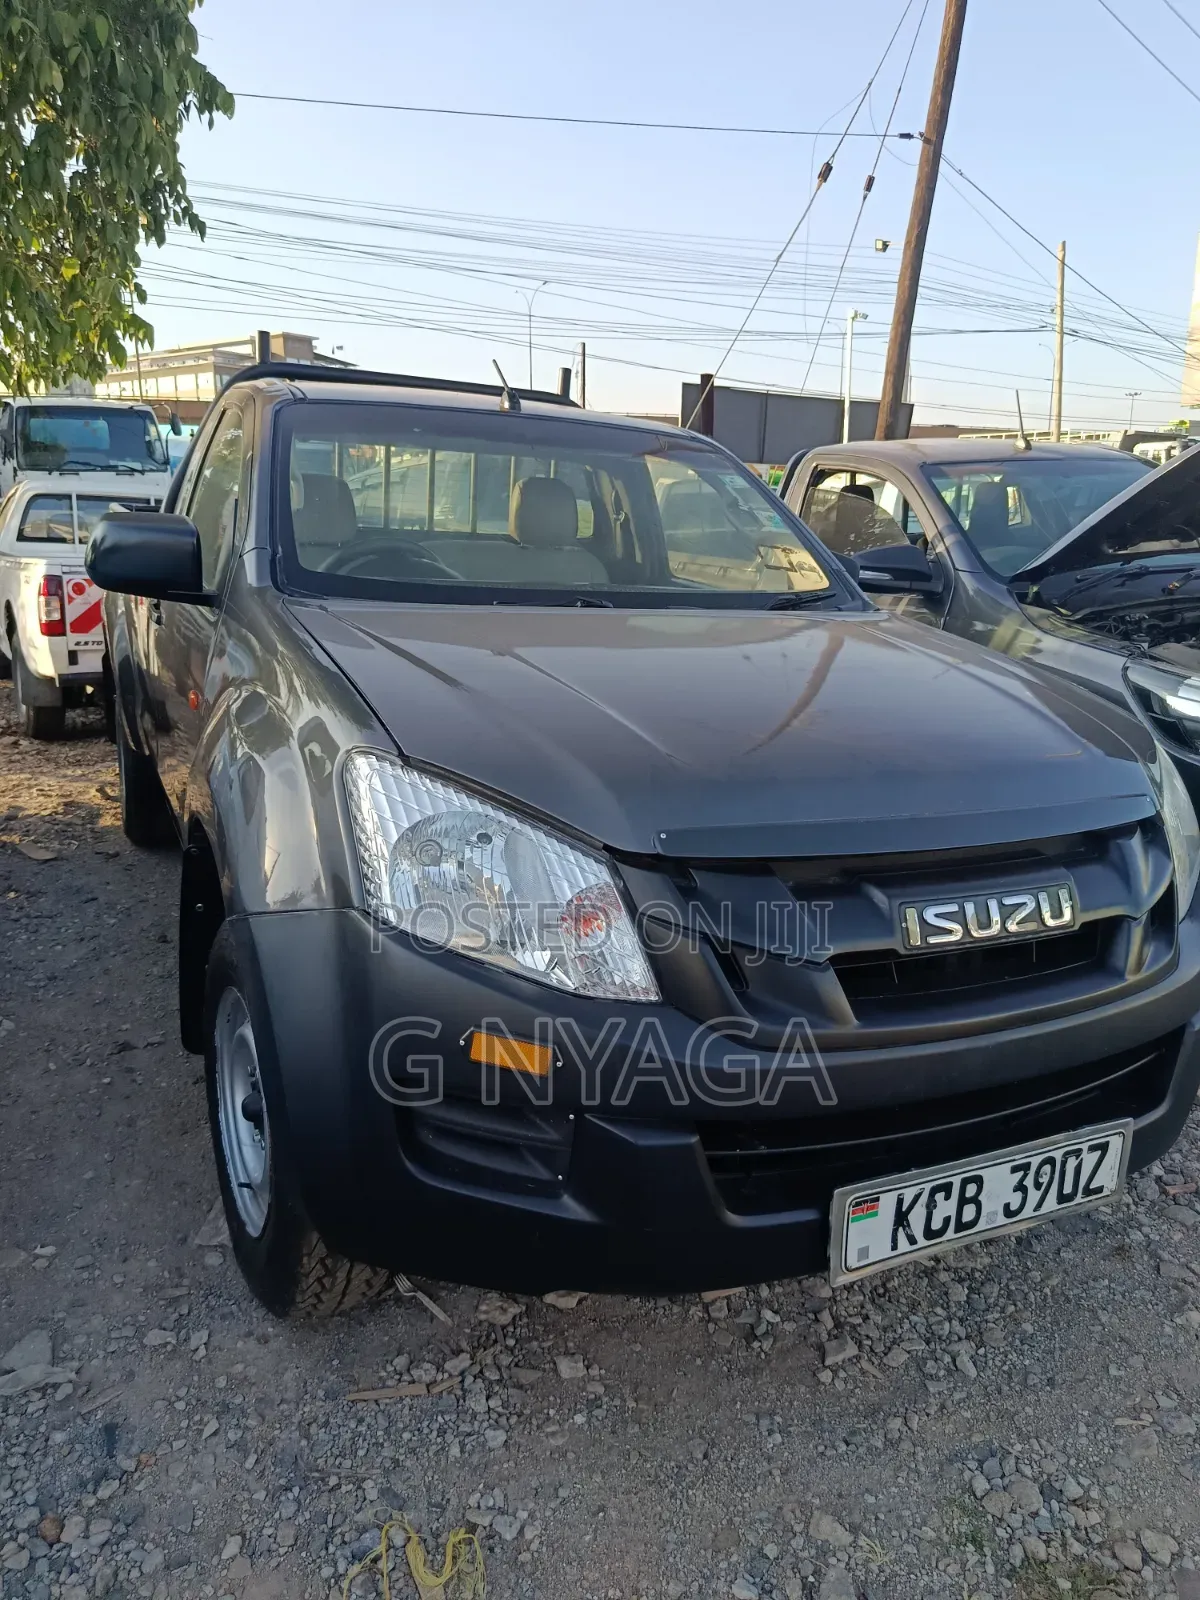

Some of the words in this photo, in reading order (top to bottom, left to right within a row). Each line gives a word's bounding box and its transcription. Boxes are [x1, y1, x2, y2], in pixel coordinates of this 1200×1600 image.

[905, 888, 1073, 946] ISUZU
[890, 1174, 985, 1252] KCB
[1002, 1140, 1110, 1219] 390Z
